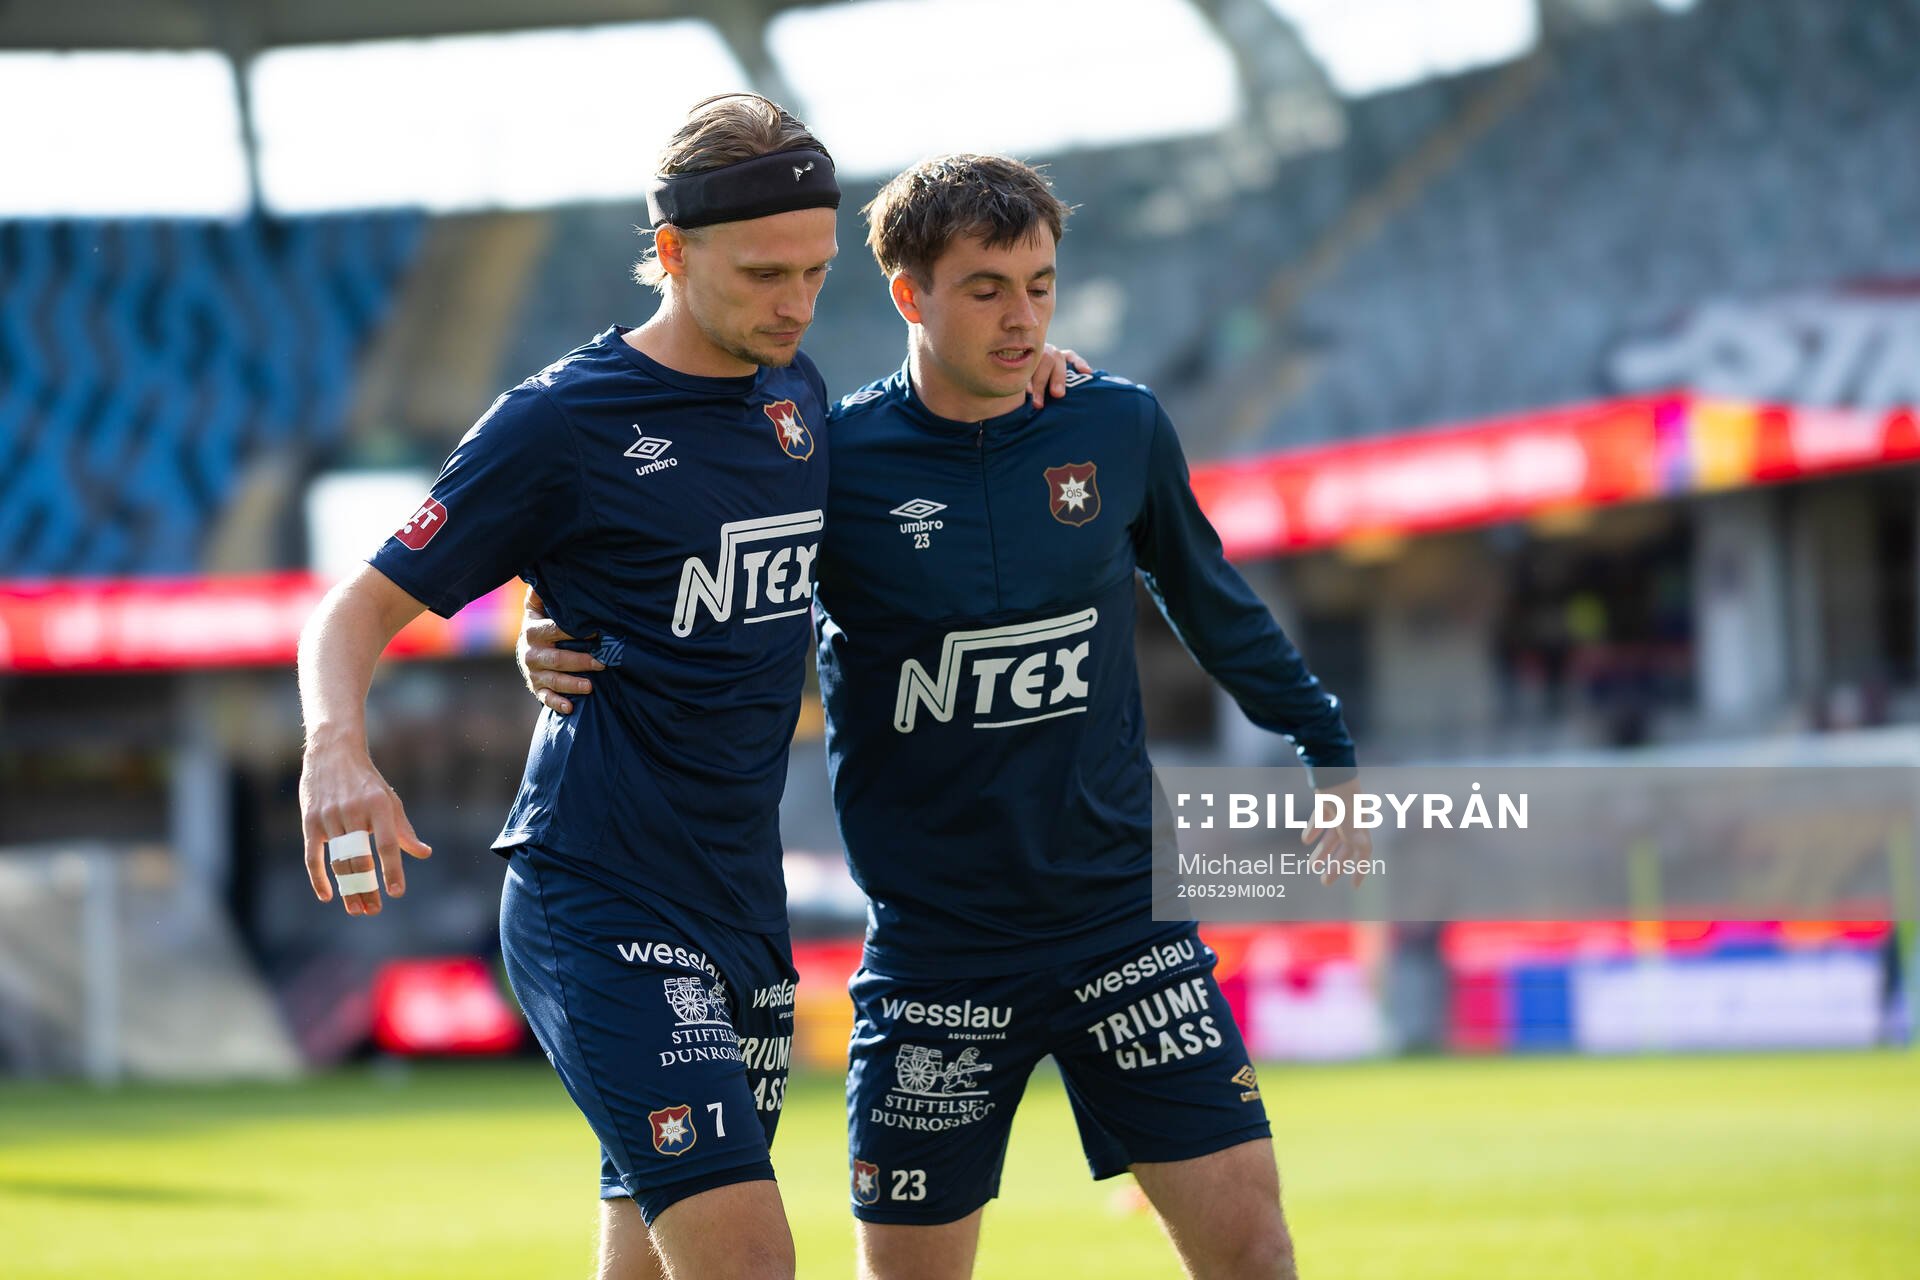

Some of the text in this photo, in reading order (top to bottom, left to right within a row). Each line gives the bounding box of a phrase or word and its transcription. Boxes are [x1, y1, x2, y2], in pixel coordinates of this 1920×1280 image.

[635, 457, 678, 476] umbro
[1065, 486, 1083, 499] ÖIS
[900, 518, 944, 534] umbro
[914, 534, 930, 549] 23
[671, 508, 824, 638] NTEX
[893, 607, 1098, 733] NTEX
[1074, 939, 1195, 1003] wesslau
[881, 997, 1013, 1028] wesslau
[1087, 977, 1209, 1052] TRIUMF
[1115, 1015, 1222, 1070] GLASS
[665, 1125, 681, 1135] ÖIS
[706, 1102, 726, 1138] 7
[891, 1169, 927, 1201] 23
